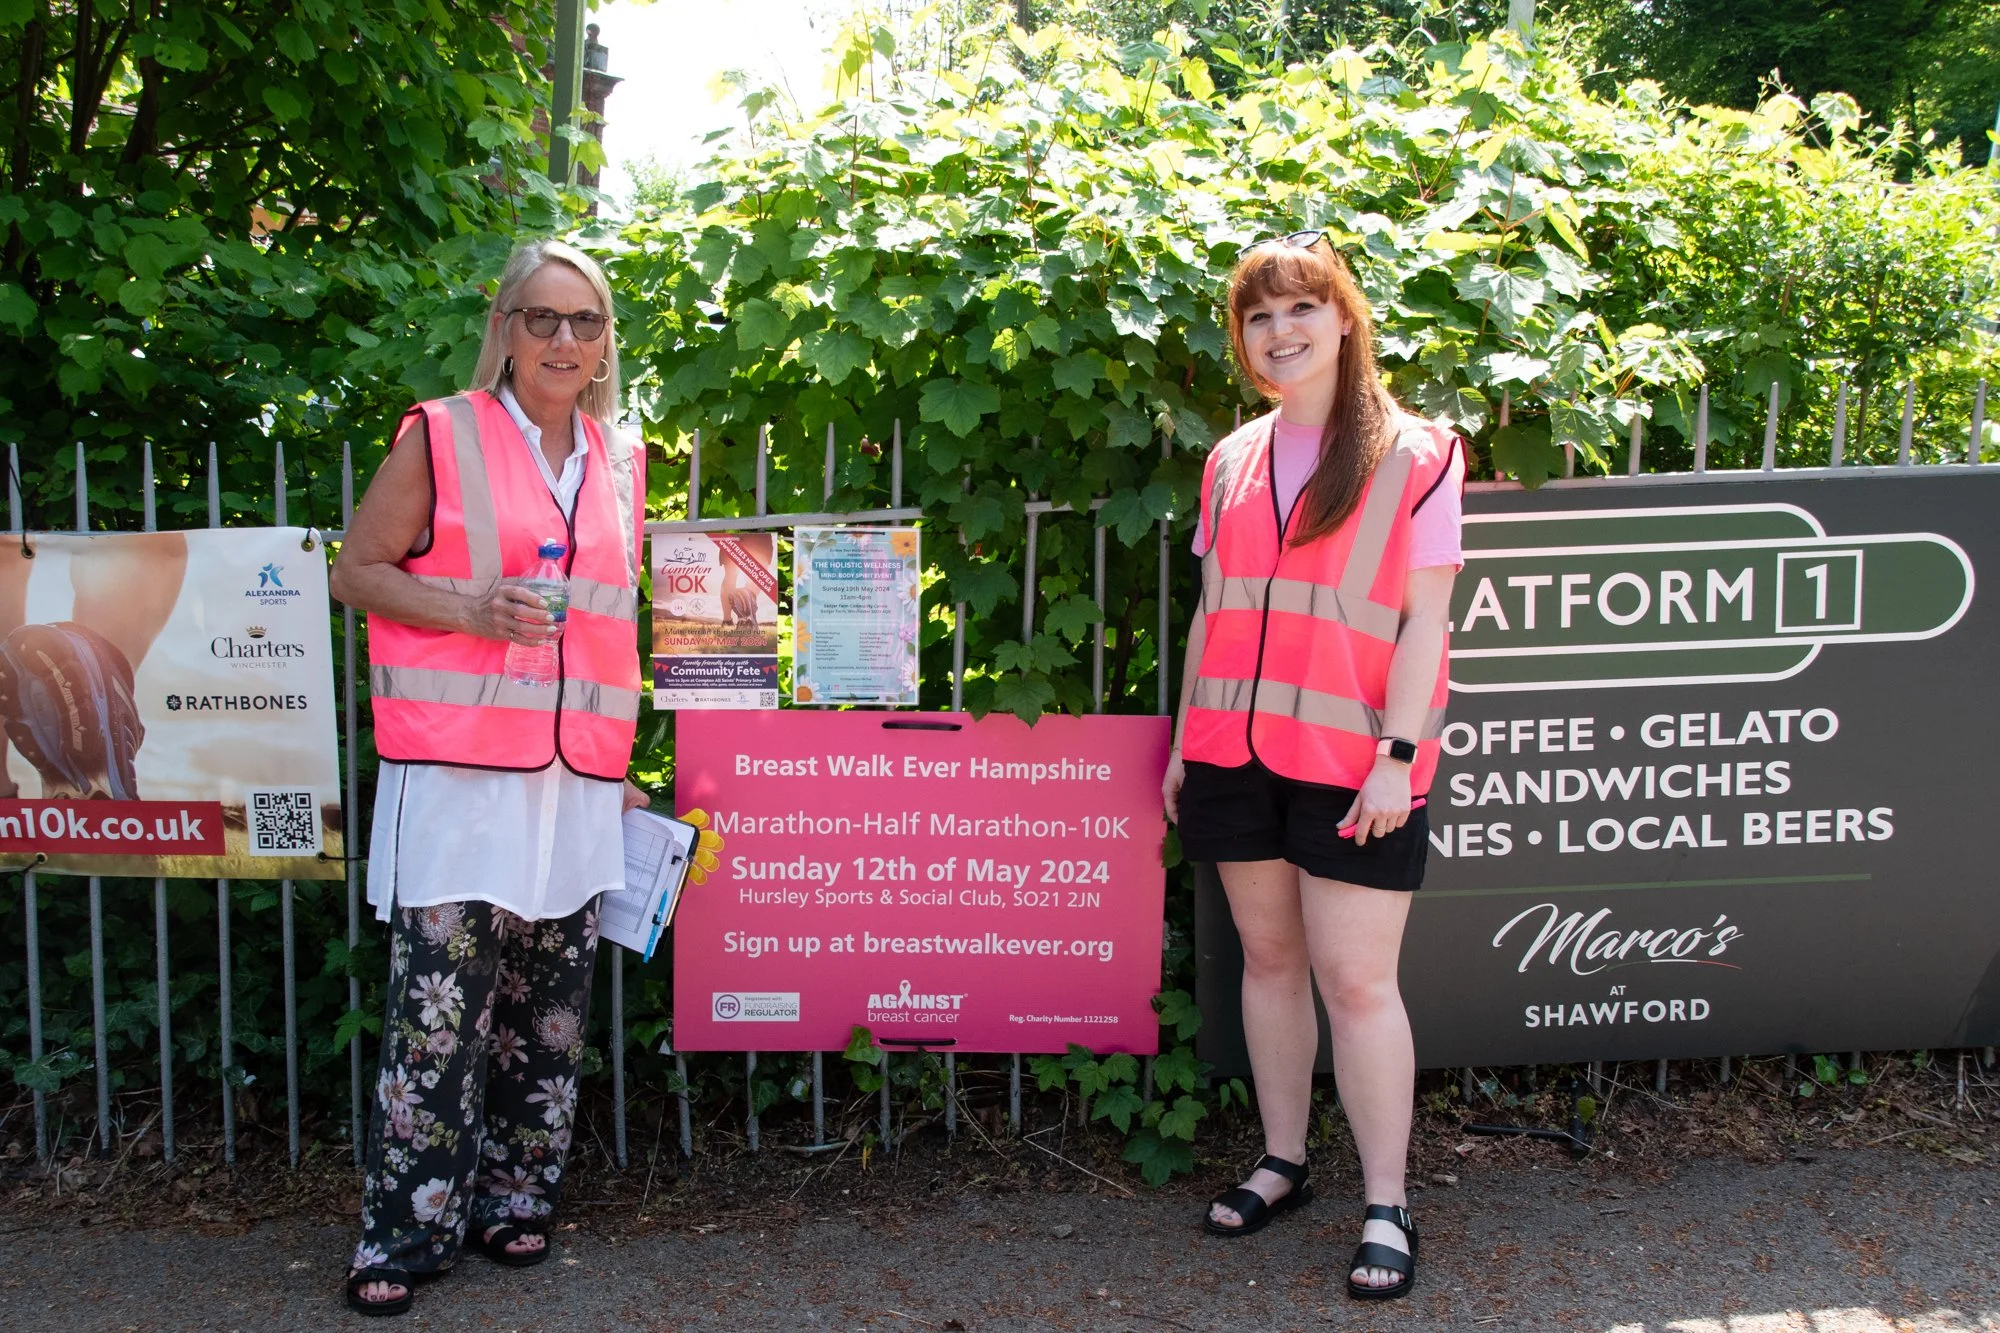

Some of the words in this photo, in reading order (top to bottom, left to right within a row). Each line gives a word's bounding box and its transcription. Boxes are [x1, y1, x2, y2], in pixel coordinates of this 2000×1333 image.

[660, 564, 712, 577] Compton
[746, 557, 760, 571] NOW
[758, 570, 775, 586] OPEN
[245, 589, 300, 597] ALEXANDRA
[667, 575, 707, 593] 10K
[260, 598, 287, 606] SPORTS
[1449, 566, 1754, 632] ATFORM
[1804, 563, 1828, 620] 1
[211, 636, 304, 659] Charters
[664, 637, 701, 646] SUNDAY
[716, 637, 738, 646] MAY
[741, 637, 768, 646] 2024
[670, 666, 735, 678] Community
[736, 666, 760, 676] Fete
[186, 694, 308, 711] RATHBONES
[1440, 716, 1594, 757] OFFEE
[1640, 707, 1839, 749] GELATO
[735, 754, 819, 777] Breast
[826, 754, 894, 777] Walk
[903, 756, 960, 778] Ever
[970, 757, 1112, 785] Hampshire
[1449, 760, 1792, 808] SANDWICHES
[0, 807, 205, 841] n10k.co.uk
[713, 810, 921, 836] Marathon-Half
[930, 813, 1130, 840] Marathon-10K
[1429, 822, 1513, 858] NES
[1558, 813, 1728, 854] LOCAL
[1743, 807, 1895, 847] BEERS
[731, 854, 842, 887] Sunday
[852, 855, 916, 881] 12th
[927, 856, 957, 881] of
[967, 858, 1031, 888] May
[1041, 860, 1110, 884] 2024
[739, 887, 809, 908] Hursley
[815, 887, 874, 907] Sports
[879, 889, 893, 905] &
[899, 888, 953, 906] Social
[959, 889, 1007, 909] Club,
[1013, 890, 1059, 908] SO21
[1067, 891, 1100, 908] 2JN
[724, 931, 779, 958] Sign
[788, 936, 821, 958] up
[829, 933, 855, 953] at
[863, 931, 1114, 962] breastwalkever.org
[1492, 903, 1744, 975] Marco's
[867, 986, 963, 1010] AGAINST
[1609, 985, 1627, 996] AT
[720, 1002, 736, 1012] FR
[867, 1009, 910, 1023] breast
[914, 1013, 960, 1023] cancer
[1525, 998, 1710, 1028] SHAWFORD
[1009, 1015, 1024, 1025] Reg.
[1026, 1014, 1051, 1025] Charity
[1052, 1015, 1082, 1024] Number
[1083, 1015, 1119, 1025] 1121258
